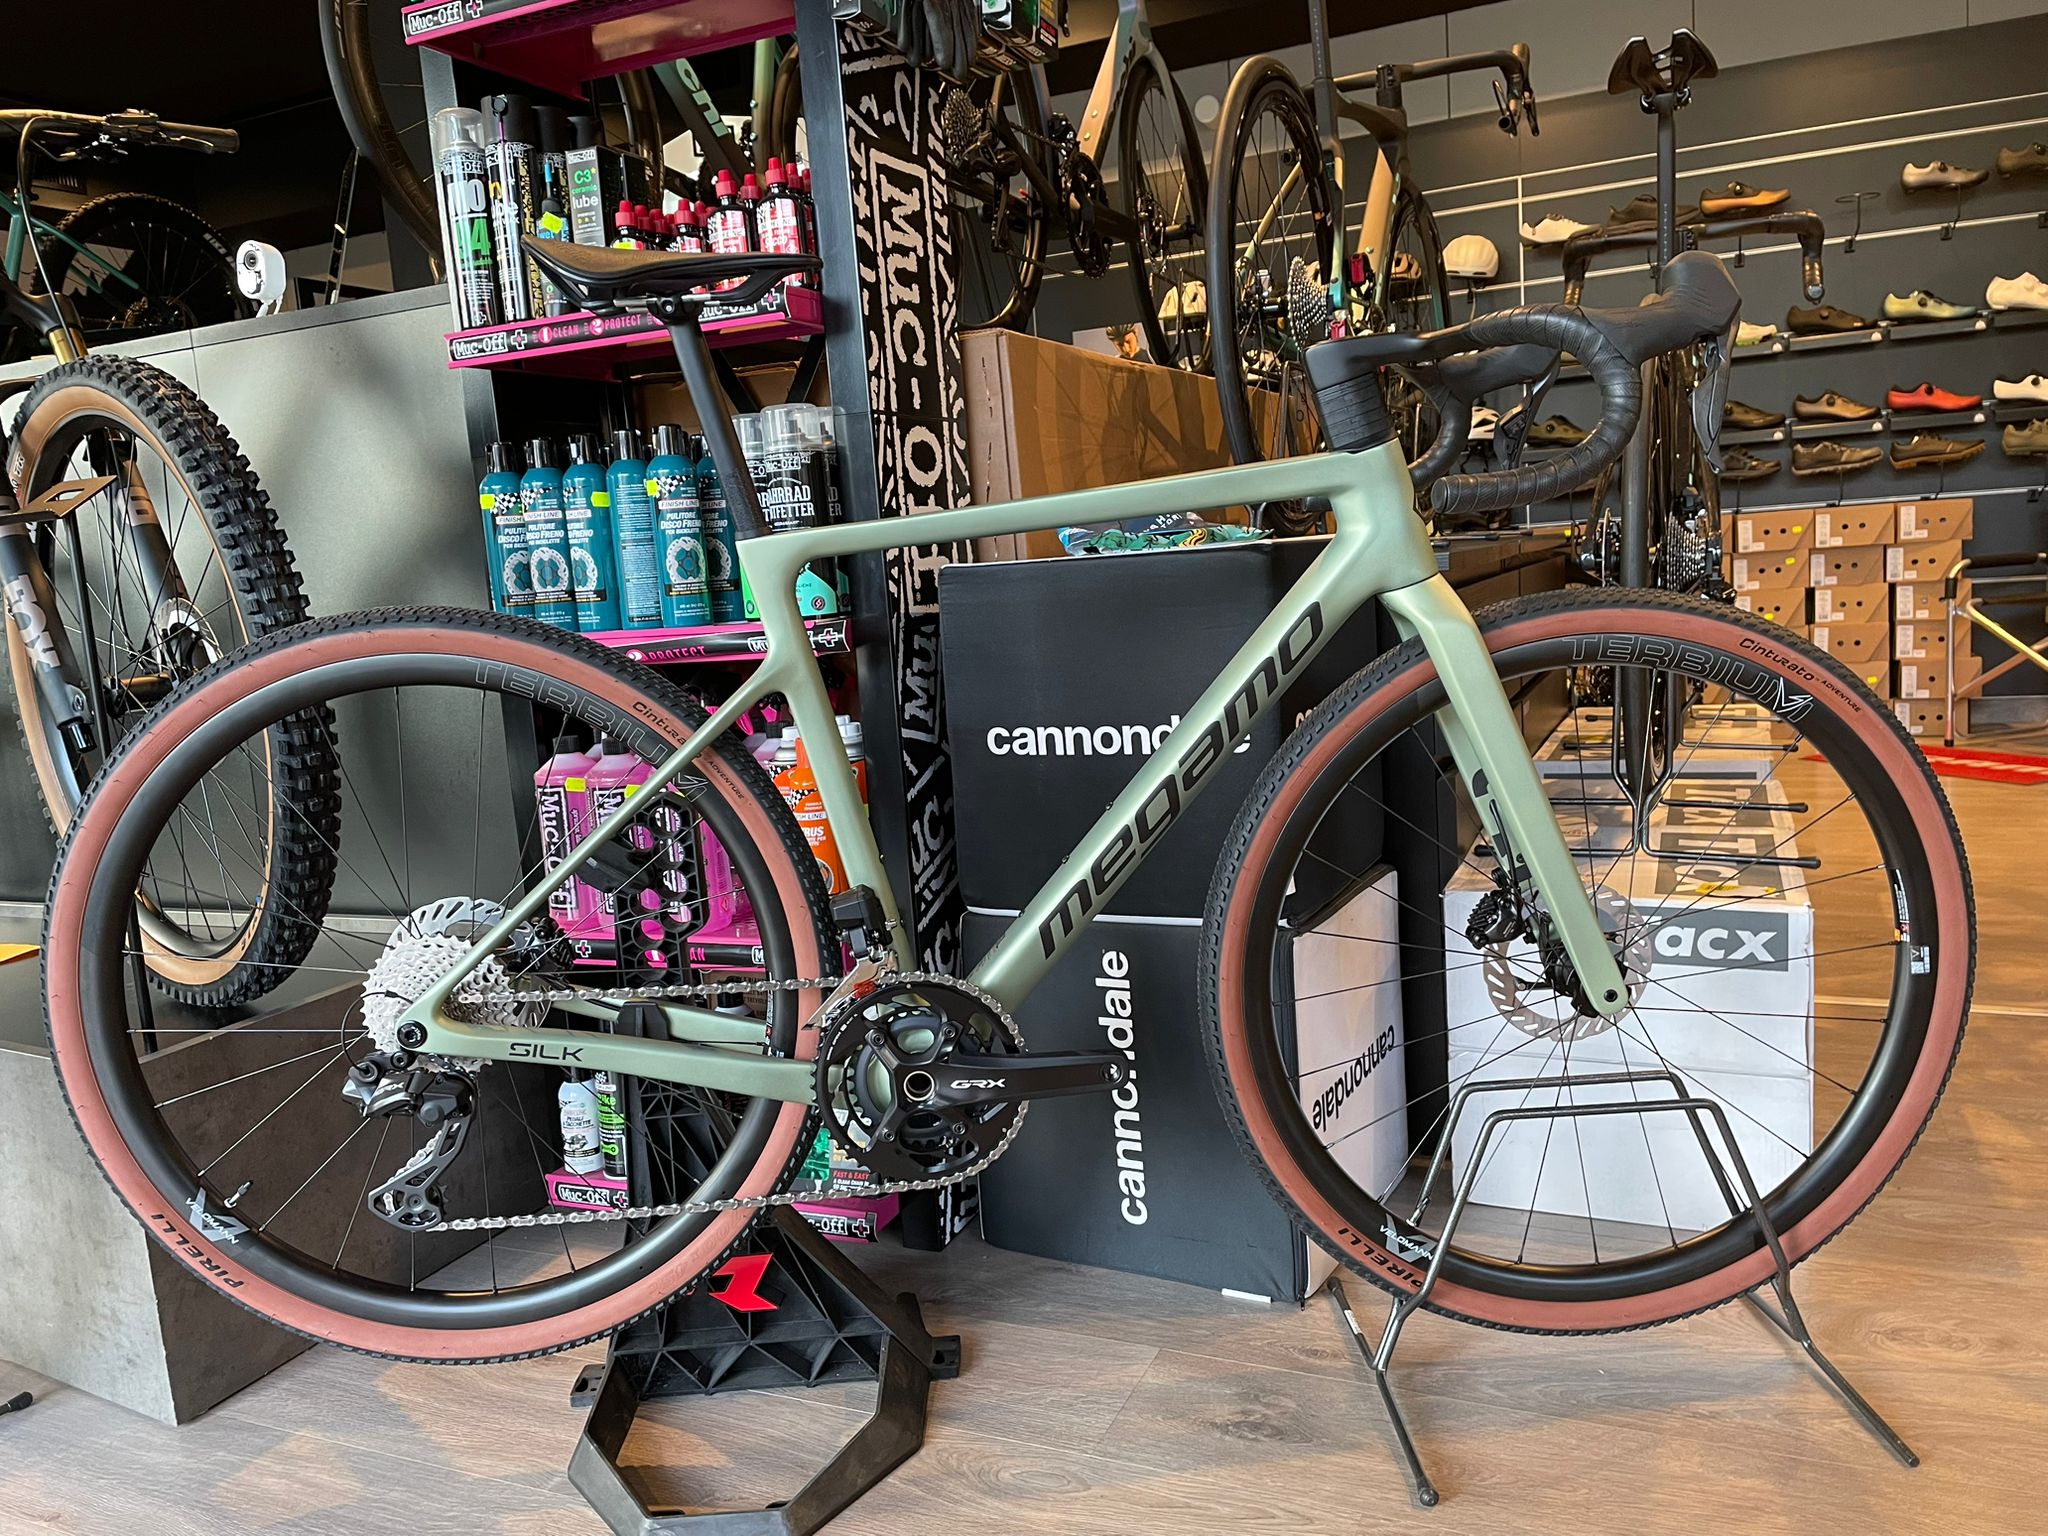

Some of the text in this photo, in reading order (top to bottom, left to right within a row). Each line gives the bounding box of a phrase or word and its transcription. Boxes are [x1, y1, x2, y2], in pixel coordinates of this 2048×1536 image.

[411, 6, 461, 32] Muc-Off
[572, 195, 599, 209] lube
[455, 336, 505, 356] Muc-Off
[553, 325, 579, 338] CLEAN
[604, 315, 641, 330] PROTECT
[661, 500, 684, 508] FINISH
[661, 520, 681, 529] DISCO
[498, 535, 519, 544] DISCO
[541, 530, 564, 539] FRENO
[1562, 634, 1814, 723] TERBIUM
[1739, 638, 1862, 713] Cinturato ADVENTURE
[632, 701, 745, 800] Cintura ADVENTURE
[1038, 601, 1323, 960] megamo
[541, 794, 573, 902] Muc-Of
[509, 1042, 584, 1062] SILK
[950, 1078, 1006, 1089] GRX
[1095, 950, 1148, 1225] cannodale
[1313, 1024, 1395, 1132] cannondale
[833, 1170, 848, 1179] FAST
[853, 1172, 870, 1180] EASY
[185, 1197, 239, 1245] VELOMANN
[151, 1213, 245, 1288] PIRELLI
[1338, 1227, 1423, 1288] PIRELLI
[1379, 1224, 1434, 1261] VELOMANN
